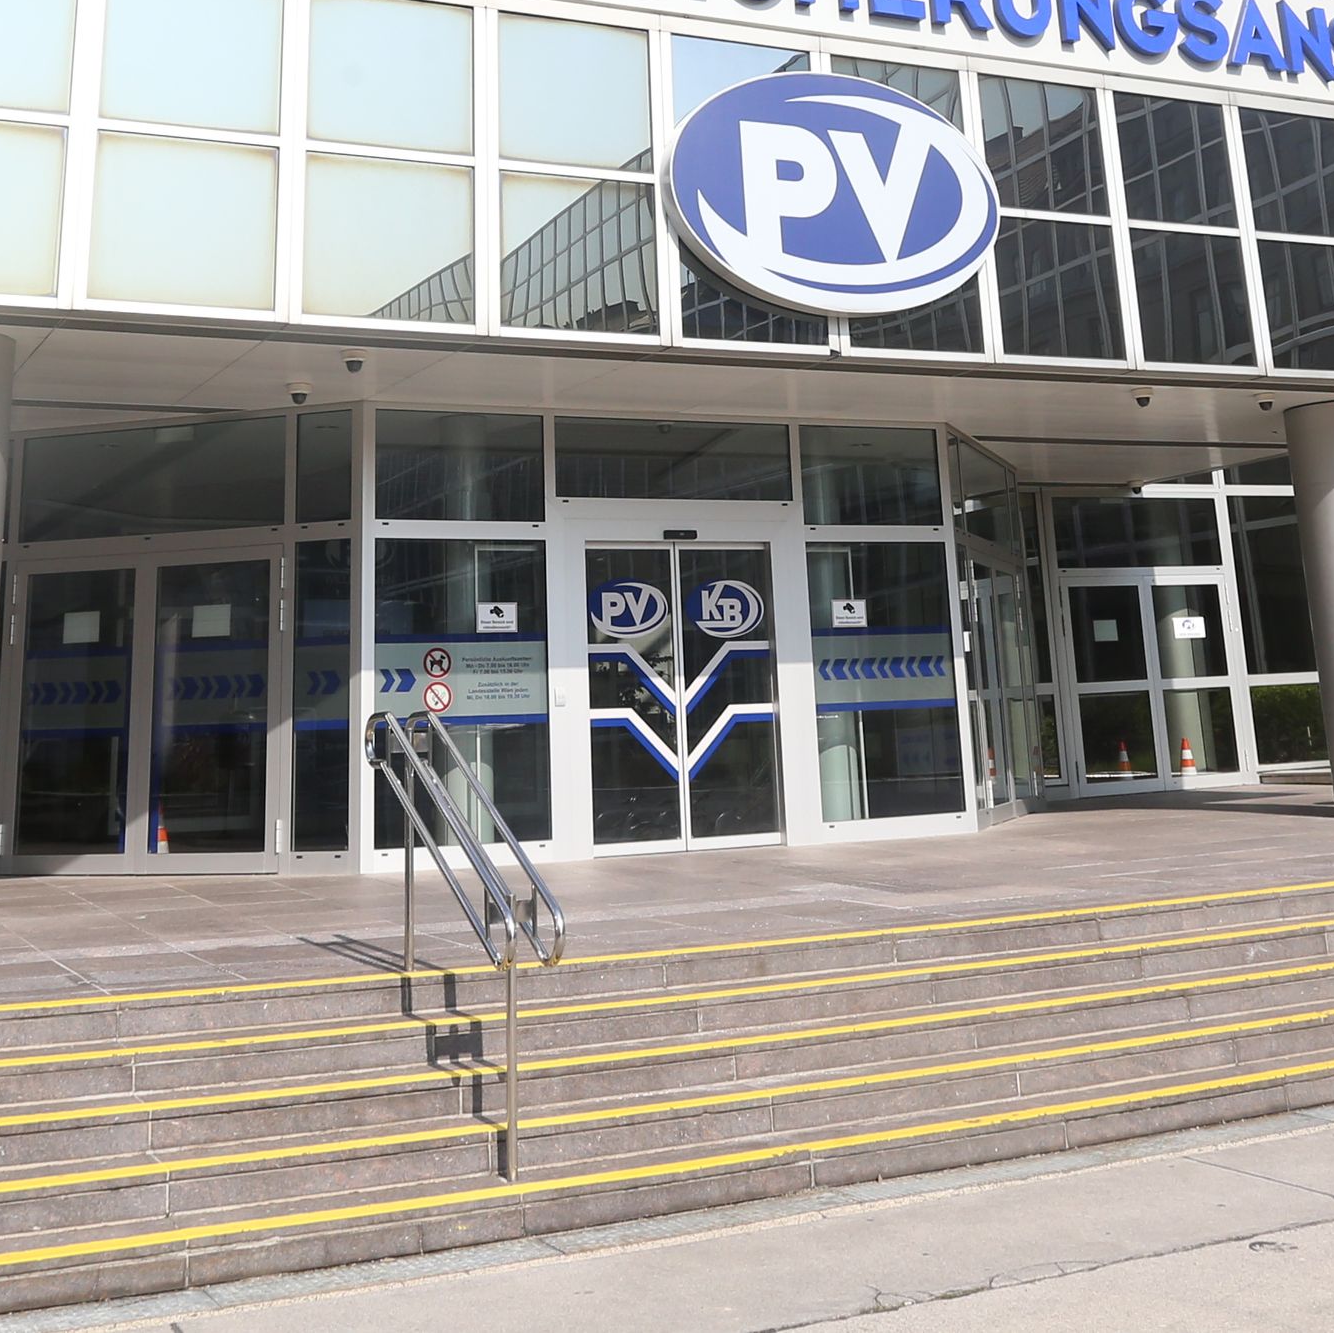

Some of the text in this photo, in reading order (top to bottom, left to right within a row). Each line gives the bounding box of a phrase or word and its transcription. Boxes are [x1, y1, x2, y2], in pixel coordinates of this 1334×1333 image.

[738, 120, 931, 266] PV
[601, 589, 652, 627] PV
[700, 585, 744, 628] KB
